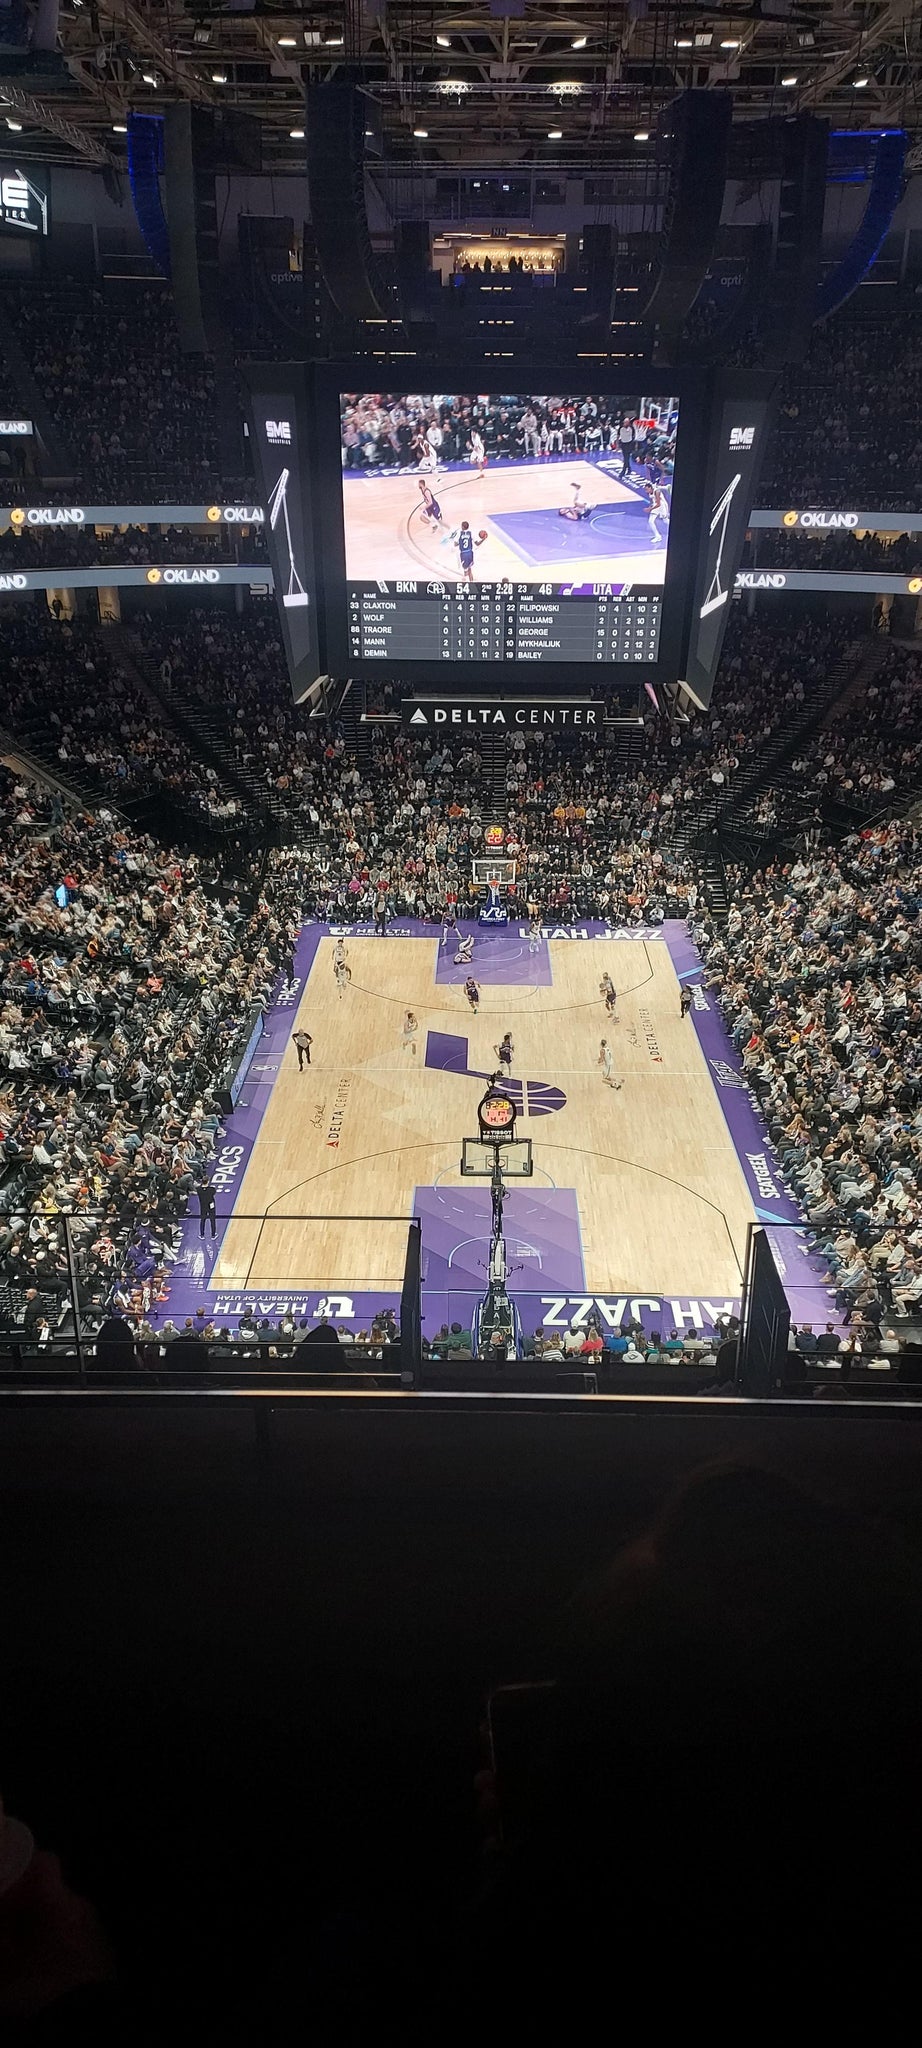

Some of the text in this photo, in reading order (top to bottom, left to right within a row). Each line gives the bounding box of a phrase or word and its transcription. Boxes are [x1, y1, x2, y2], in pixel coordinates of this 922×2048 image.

[266, 420, 291, 438] SME
[730, 428, 755, 444] SME
[28, 509, 84, 524] OKLAND
[800, 512, 858, 527] OKLAND
[164, 569, 220, 583] OKLAND
[396, 581, 417, 592] BKN
[457, 583, 469, 594] 54
[496, 584, 513, 594] 2:28
[539, 584, 552, 595] 46
[593, 584, 612, 595] UTA
[434, 709, 596, 724] DELTA CENTER
[519, 928, 664, 940] UTAH JAZZ
[639, 1008, 660, 1056] DELTA CENTER
[328, 1079, 351, 1138] DELTA CENTER
[212, 1146, 244, 1184] PACS
[745, 1152, 780, 1198] SEATGEEK
[212, 1302, 306, 1314] HEALTH
[541, 1298, 742, 1328] AH JAZZ
